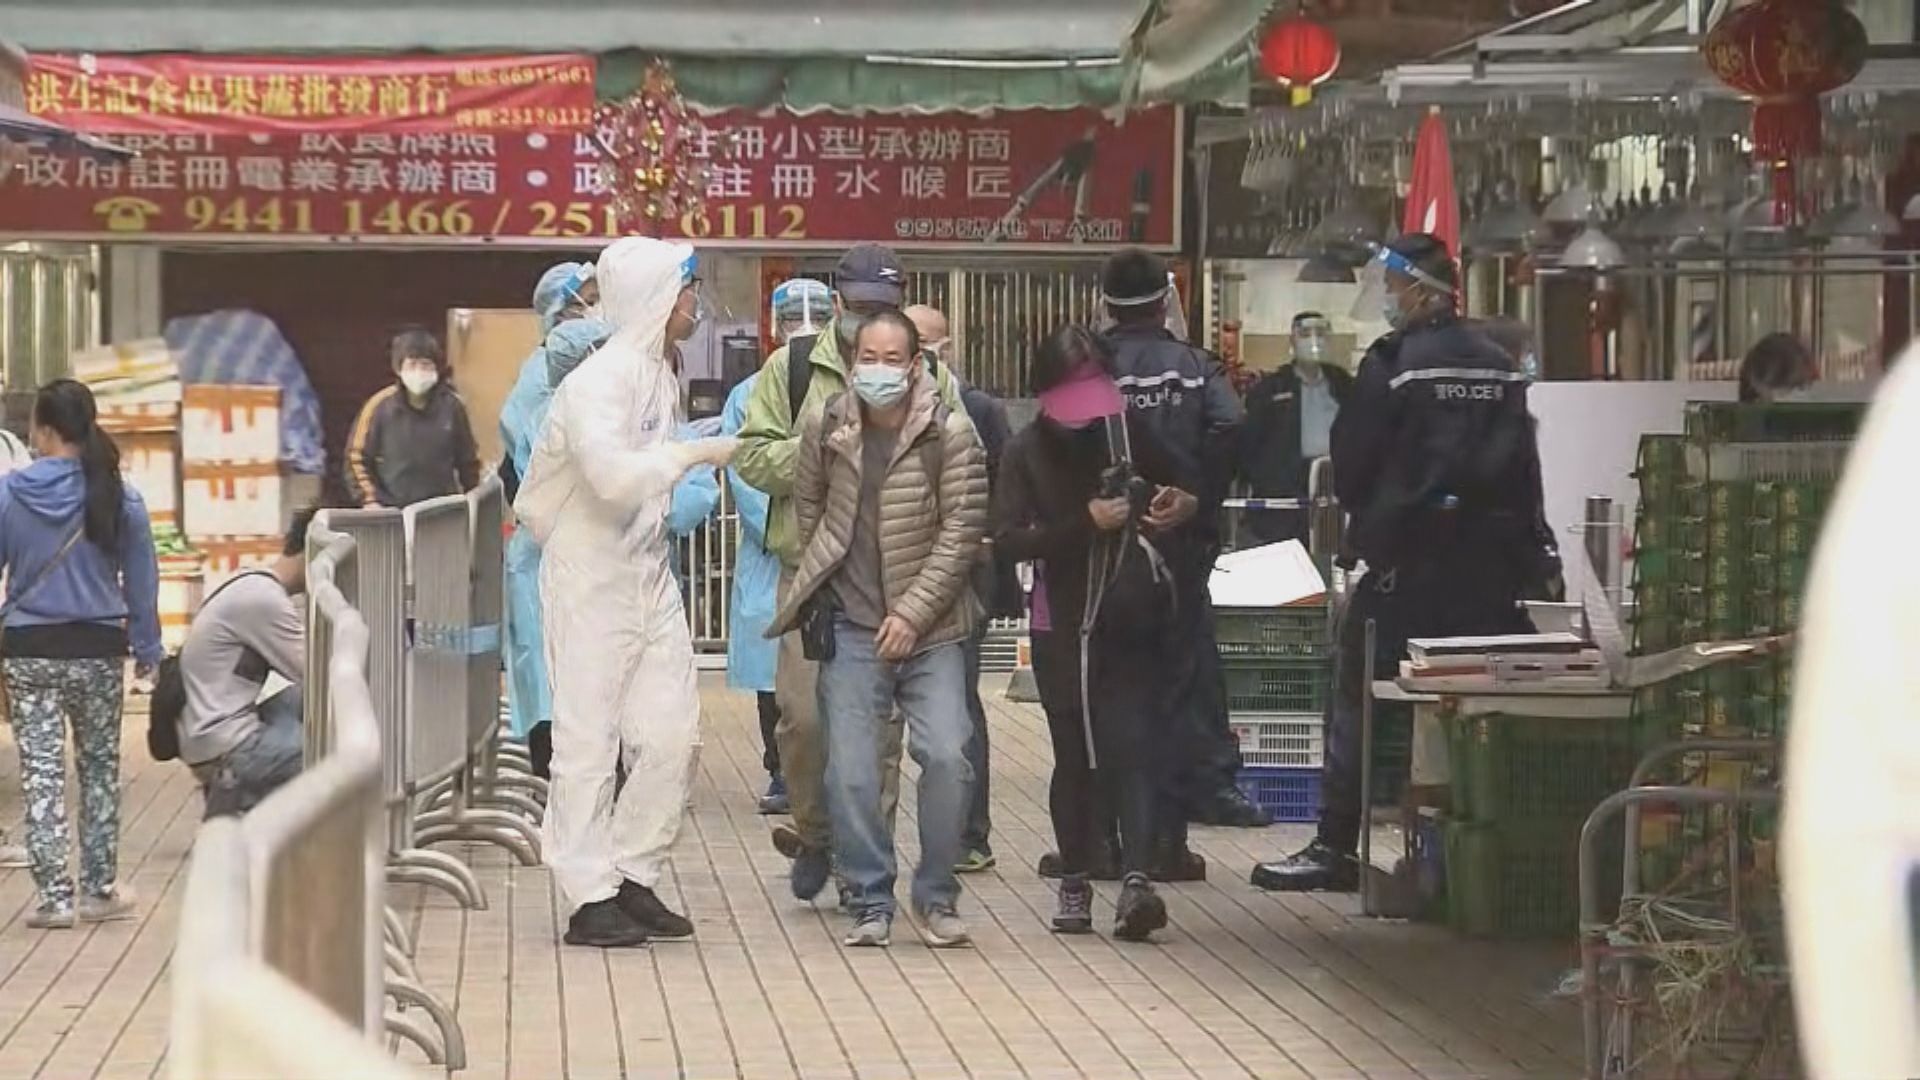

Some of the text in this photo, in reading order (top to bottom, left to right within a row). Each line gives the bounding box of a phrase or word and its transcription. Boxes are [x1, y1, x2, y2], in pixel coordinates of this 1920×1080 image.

[26, 74, 449, 119] 洪生記食品果蔬批發商行
[574, 125, 1010, 161] 政冊小型承辦商
[22, 154, 497, 194] 政府註冊電業承辦商
[573, 162, 1011, 199] 政註冊水喉匠
[186, 200, 807, 239] 9441 1466 / 251 6112
